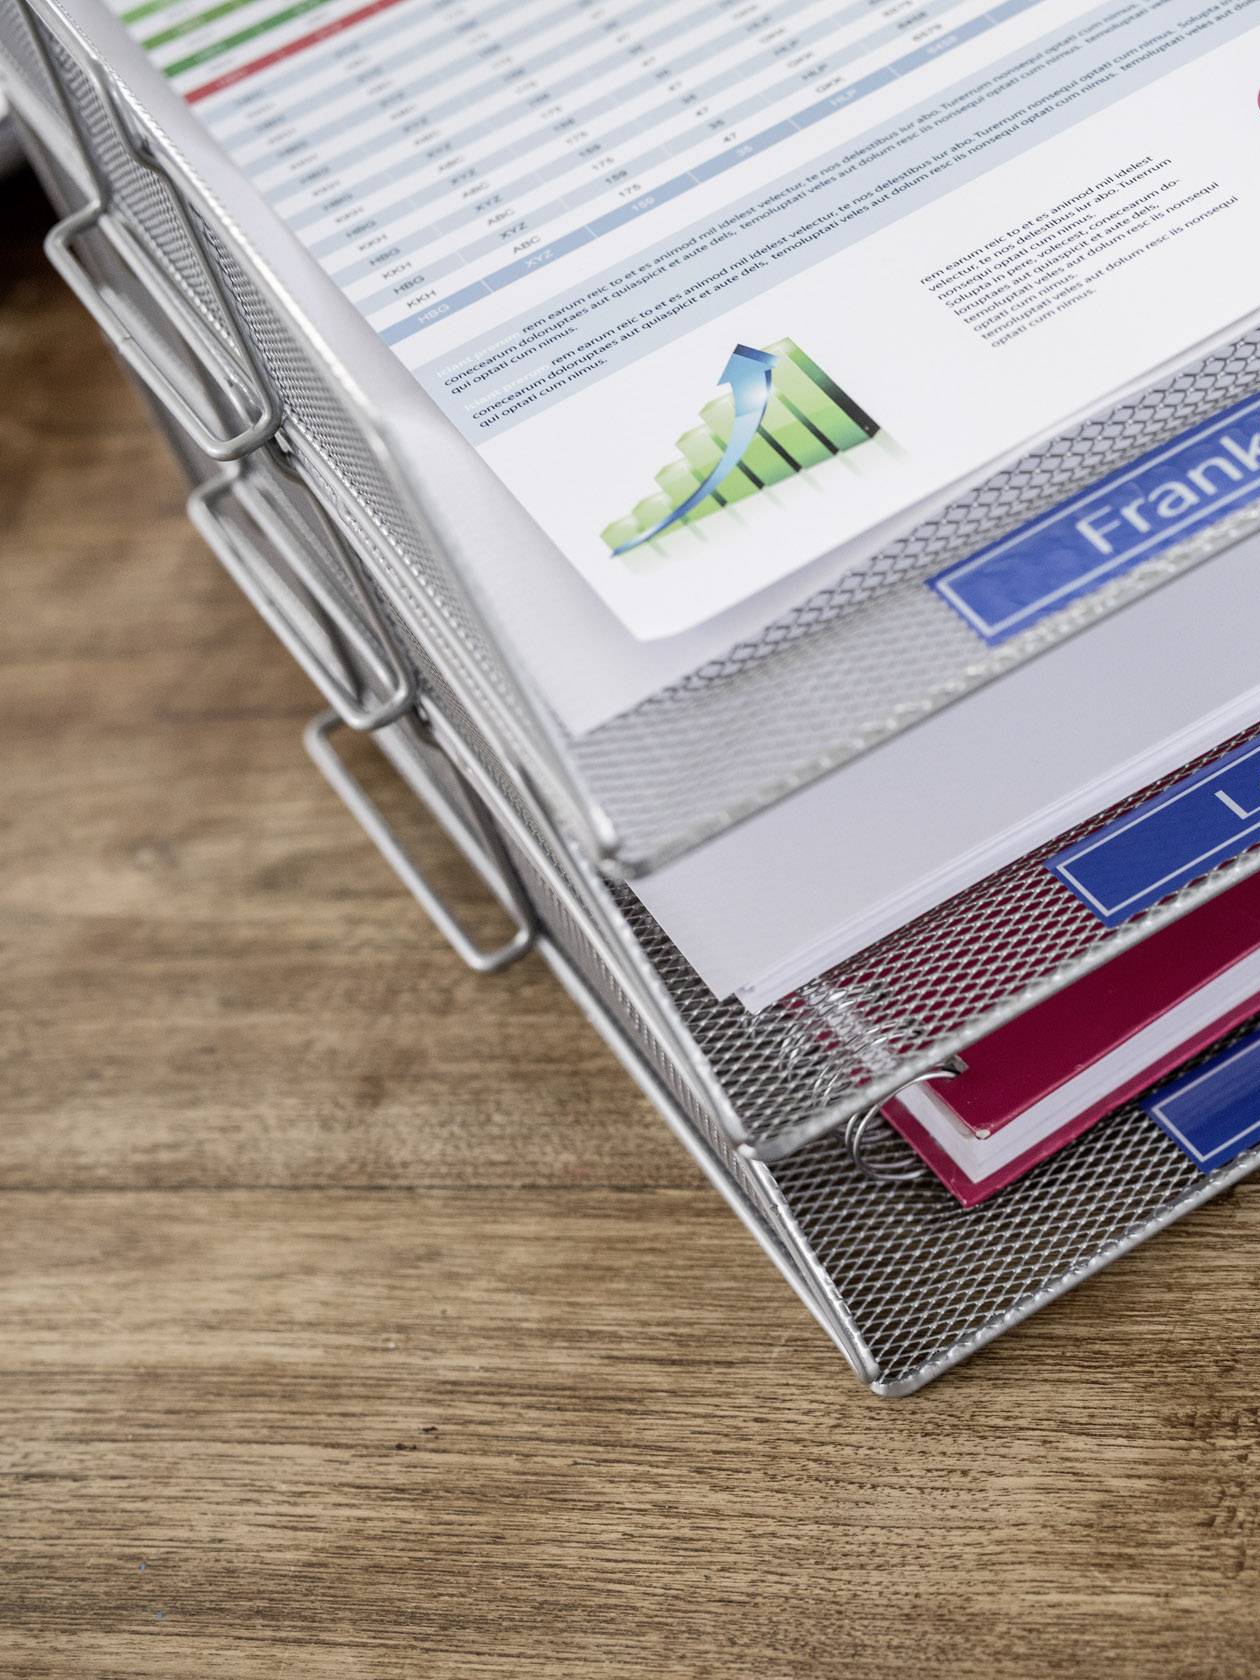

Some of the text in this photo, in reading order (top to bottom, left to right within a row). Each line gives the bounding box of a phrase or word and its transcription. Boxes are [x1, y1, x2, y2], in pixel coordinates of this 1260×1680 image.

[393, 275, 425, 294] HBG
[499, 222, 527, 239] XYZ
[920, 156, 1154, 285] rem earum reic to et es animod mil idelest
[945, 281, 992, 307] Solupta
[991, 274, 1006, 283] in
[1088, 190, 1160, 231] conecearum
[1160, 179, 1180, 192] do-
[963, 181, 1220, 324] temoluptati veles aut dolum resc iis nonsequi
[978, 256, 992, 265] te
[993, 244, 1016, 258] nos
[1016, 212, 1076, 245] delestibus
[1074, 201, 1092, 213] iur
[1119, 158, 1172, 189] Turerrum
[406, 290, 437, 308] KKH
[513, 236, 541, 254] ABC
[444, 244, 708, 386] conecearum doloruptaes aut quiaspicit et aute
[472, 378, 547, 420] conecearum
[547, 340, 619, 380] doloruptaes
[620, 327, 641, 341] aut
[641, 297, 698, 330] quiaspicit
[699, 289, 712, 299] et
[713, 275, 739, 292] aute
[770, 220, 840, 260] temoluptati
[839, 205, 870, 223] veles
[522, 262, 653, 334] rem earum reic to et es
[551, 350, 576, 366] rem
[576, 329, 616, 352] earum
[616, 316, 639, 331] reic
[639, 309, 654, 318] to
[654, 301, 667, 311] et
[668, 293, 683, 303] es
[683, 267, 729, 296] animod
[729, 257, 749, 271] mil
[748, 236, 788, 260] idelest
[937, 267, 993, 301] nonsequi
[993, 247, 1029, 270] optati
[1029, 234, 1057, 250] cum
[953, 284, 1011, 317] loruptaes
[1013, 272, 1032, 285] aut
[1033, 240, 1089, 274] quiaspicit
[1090, 233, 1103, 242] et
[1105, 218, 1131, 235] aute
[973, 309, 1009, 332] optati
[1010, 294, 1038, 312] cum
[451, 380, 472, 395] qui
[473, 360, 509, 383] optati
[510, 347, 537, 364] cum
[479, 413, 500, 428] qui
[501, 393, 538, 416] optati
[539, 379, 567, 396] cum
